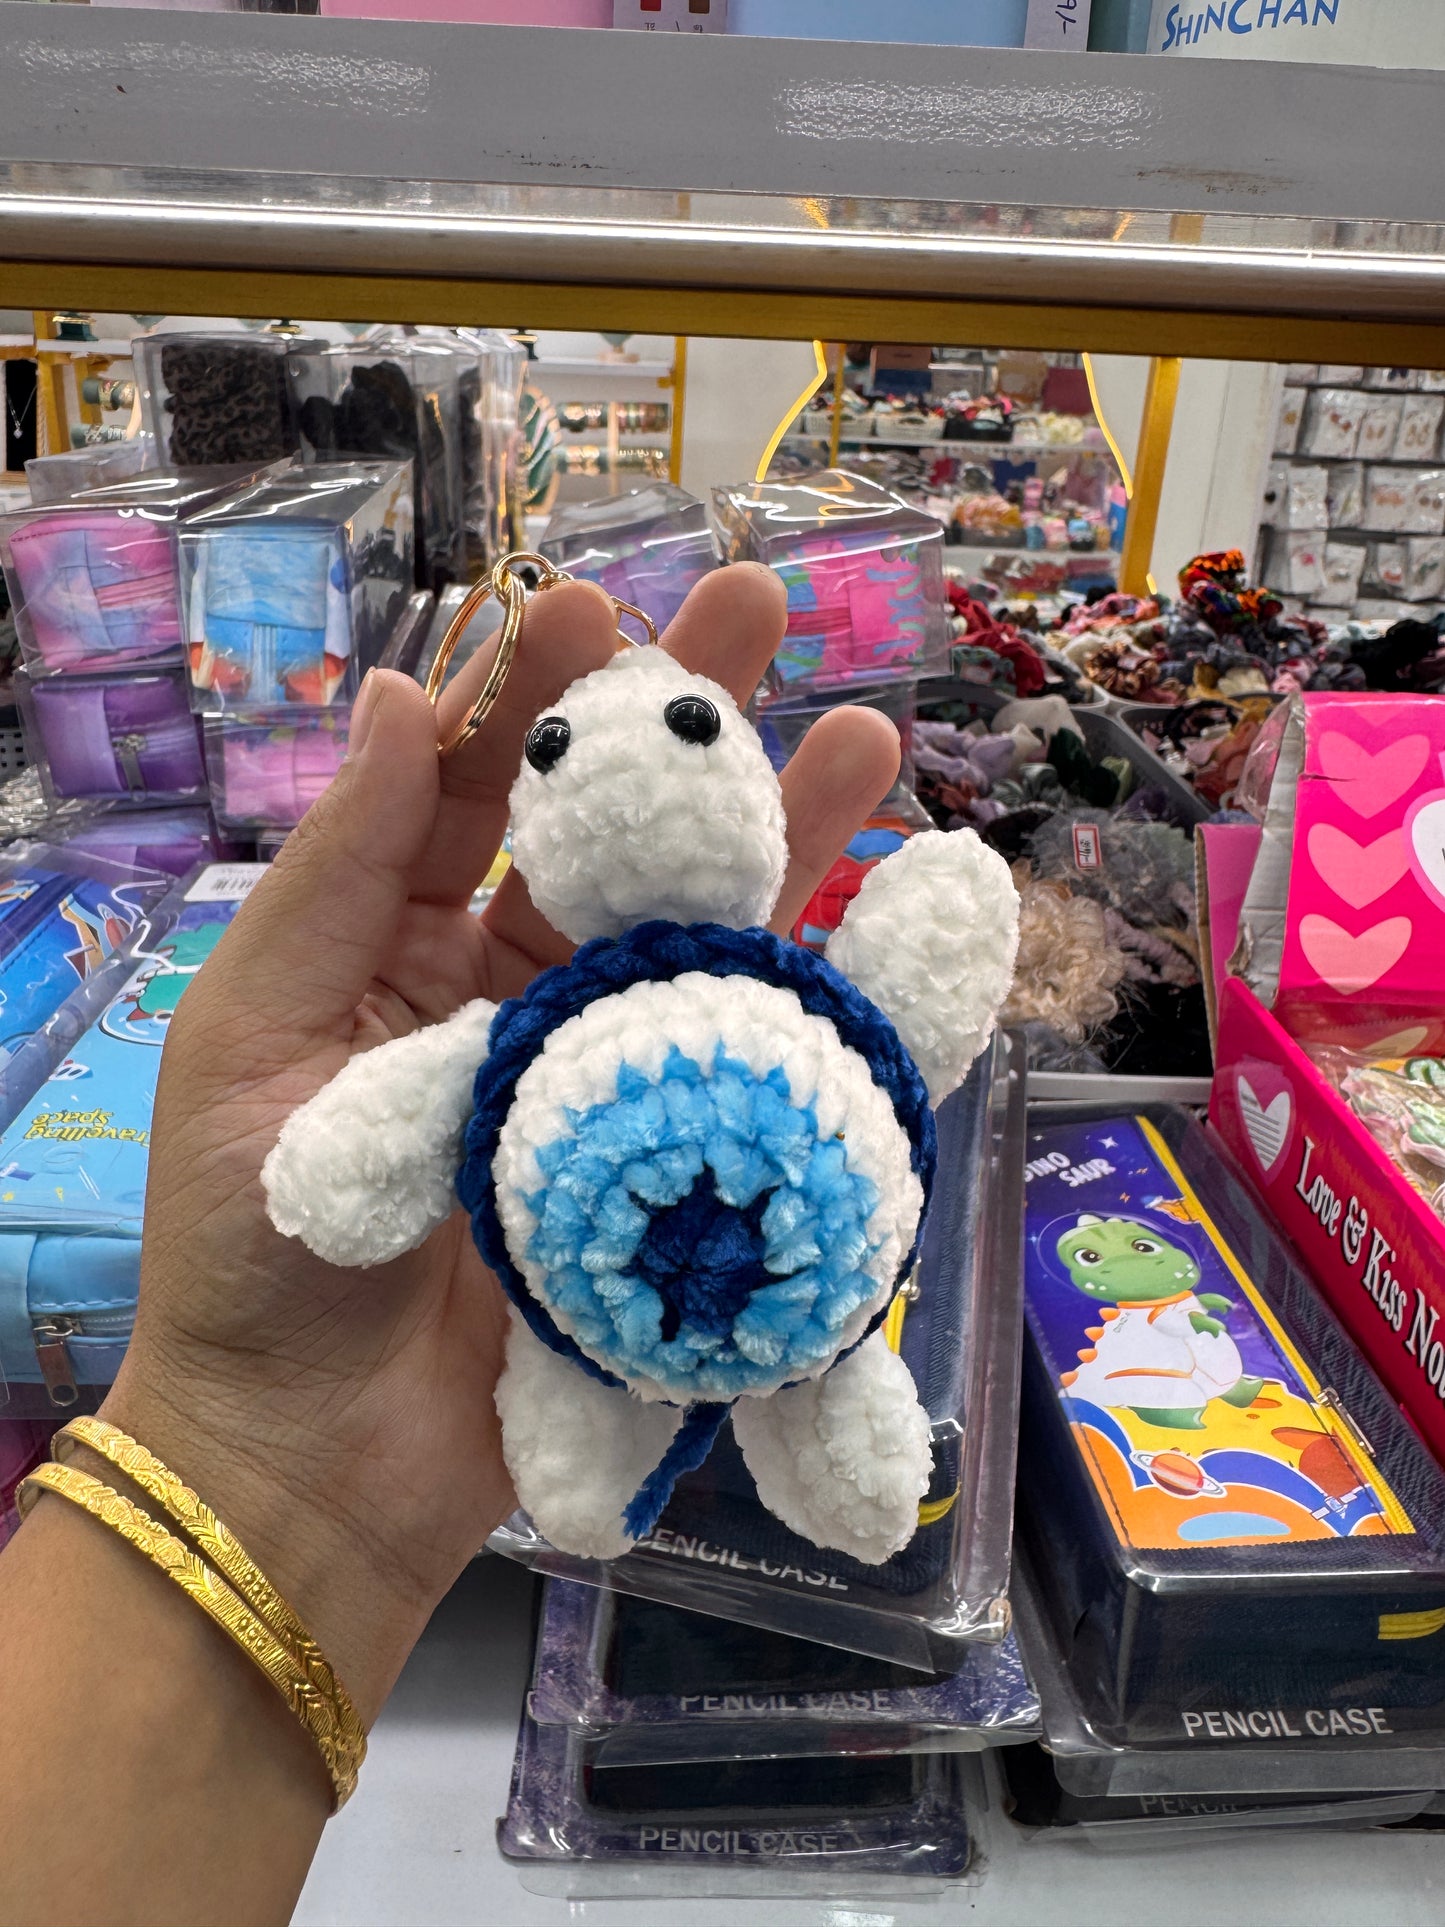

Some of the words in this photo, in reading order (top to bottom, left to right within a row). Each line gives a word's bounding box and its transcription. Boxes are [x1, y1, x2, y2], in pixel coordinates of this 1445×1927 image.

[1161, 0, 1338, 51] SHINCHAN
[1059, 1158, 1117, 1187] SAUR
[1296, 1135, 1342, 1237] Love
[1342, 1195, 1368, 1264] &
[1362, 1227, 1407, 1332] Kiss
[638, 1528, 748, 1570] ENCIL
[1181, 1710, 1302, 1737] PENCIL
[1305, 1708, 1394, 1736] CASE
[639, 1826, 751, 1855] PENCIL
[757, 1831, 838, 1856] CASE
